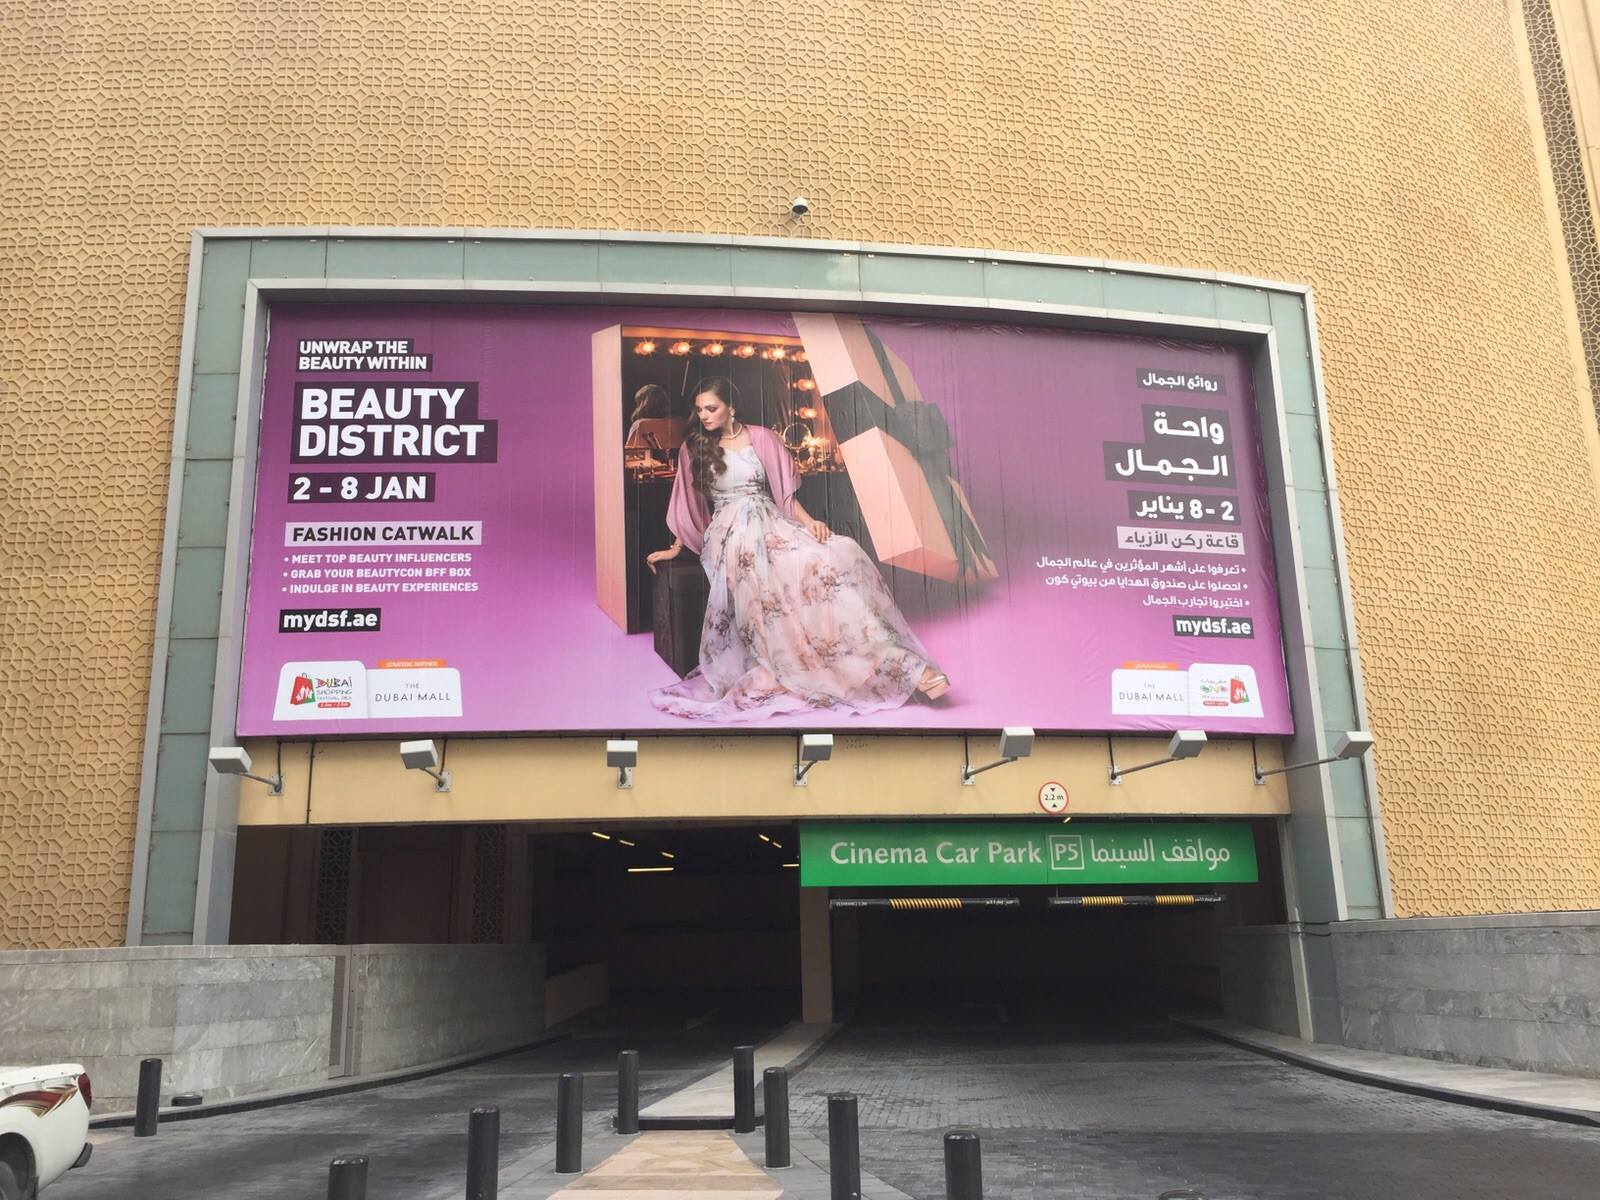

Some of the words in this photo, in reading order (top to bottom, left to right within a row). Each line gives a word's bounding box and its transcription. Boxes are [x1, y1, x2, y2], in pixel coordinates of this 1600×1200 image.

[300, 340, 373, 354] UNWRAP
[375, 340, 408, 354] THE
[298, 356, 365, 370] BEAUTY
[366, 356, 427, 370] WITHIN
[1142, 373, 1185, 388] الجمال
[1187, 375, 1218, 391] روائع
[301, 387, 465, 420] BEAUTY
[1153, 410, 1224, 445] واحة
[299, 424, 485, 456] DISTRICT
[1114, 448, 1228, 481] الجمال
[293, 477, 311, 500] 2
[340, 476, 358, 499] 8
[365, 476, 427, 500] JAN
[1136, 495, 1184, 520] يناير
[1189, 499, 1203, 519] 8
[1220, 501, 1235, 521] 2
[292, 527, 376, 542] FASHION
[382, 526, 474, 541] CATWALK
[1125, 531, 1168, 547] الأزياء
[1206, 534, 1239, 548] قاعة
[1171, 534, 1203, 549] ركن
[292, 554, 323, 564] MEET
[325, 554, 347, 563] TOP
[349, 553, 392, 563] BEAUTY
[395, 553, 472, 563] INFLUENCERS
[1036, 556, 1072, 569] الجمال
[1072, 558, 1098, 569] عالم
[1100, 558, 1113, 573] في
[1114, 558, 1158, 572] المؤثرين
[290, 569, 321, 579] GRAB
[324, 569, 354, 578] YOUR
[356, 568, 422, 578] BEAUTYCON
[425, 568, 447, 577] BFF
[449, 567, 472, 577] BOX
[1160, 560, 1187, 573] أشهر
[1188, 563, 1206, 575] على
[1208, 563, 1240, 576] تعرفوا
[1045, 574, 1069, 585] كون
[1070, 574, 1098, 589] بيوتي
[1098, 577, 1116, 587] من
[1117, 576, 1150, 588] الهدايا
[1151, 577, 1187, 590] صندوق
[1188, 580, 1206, 591] على
[1207, 581, 1241, 592] احصلوا
[290, 584, 339, 594] INDULGE
[341, 583, 353, 593] IN
[355, 583, 400, 593] BEAUTY
[402, 582, 479, 592] EXPERIENCES
[1142, 594, 1176, 607] الجمال
[1177, 596, 1208, 609] تجارب
[1209, 597, 1243, 609] اختبروا
[283, 610, 378, 632] mydsf.ae
[1176, 617, 1252, 636] mydsf.ae
[375, 693, 413, 702] DUBAI
[418, 692, 451, 701] MALL
[1119, 692, 1152, 701] DUBAI
[1155, 693, 1185, 702] MALL
[830, 842, 928, 864] Cinema
[936, 841, 979, 864] Car
[988, 841, 1042, 863] Park
[1055, 843, 1079, 862] P5
[1090, 838, 1155, 869] السينما
[1162, 838, 1231, 871] مواقف
